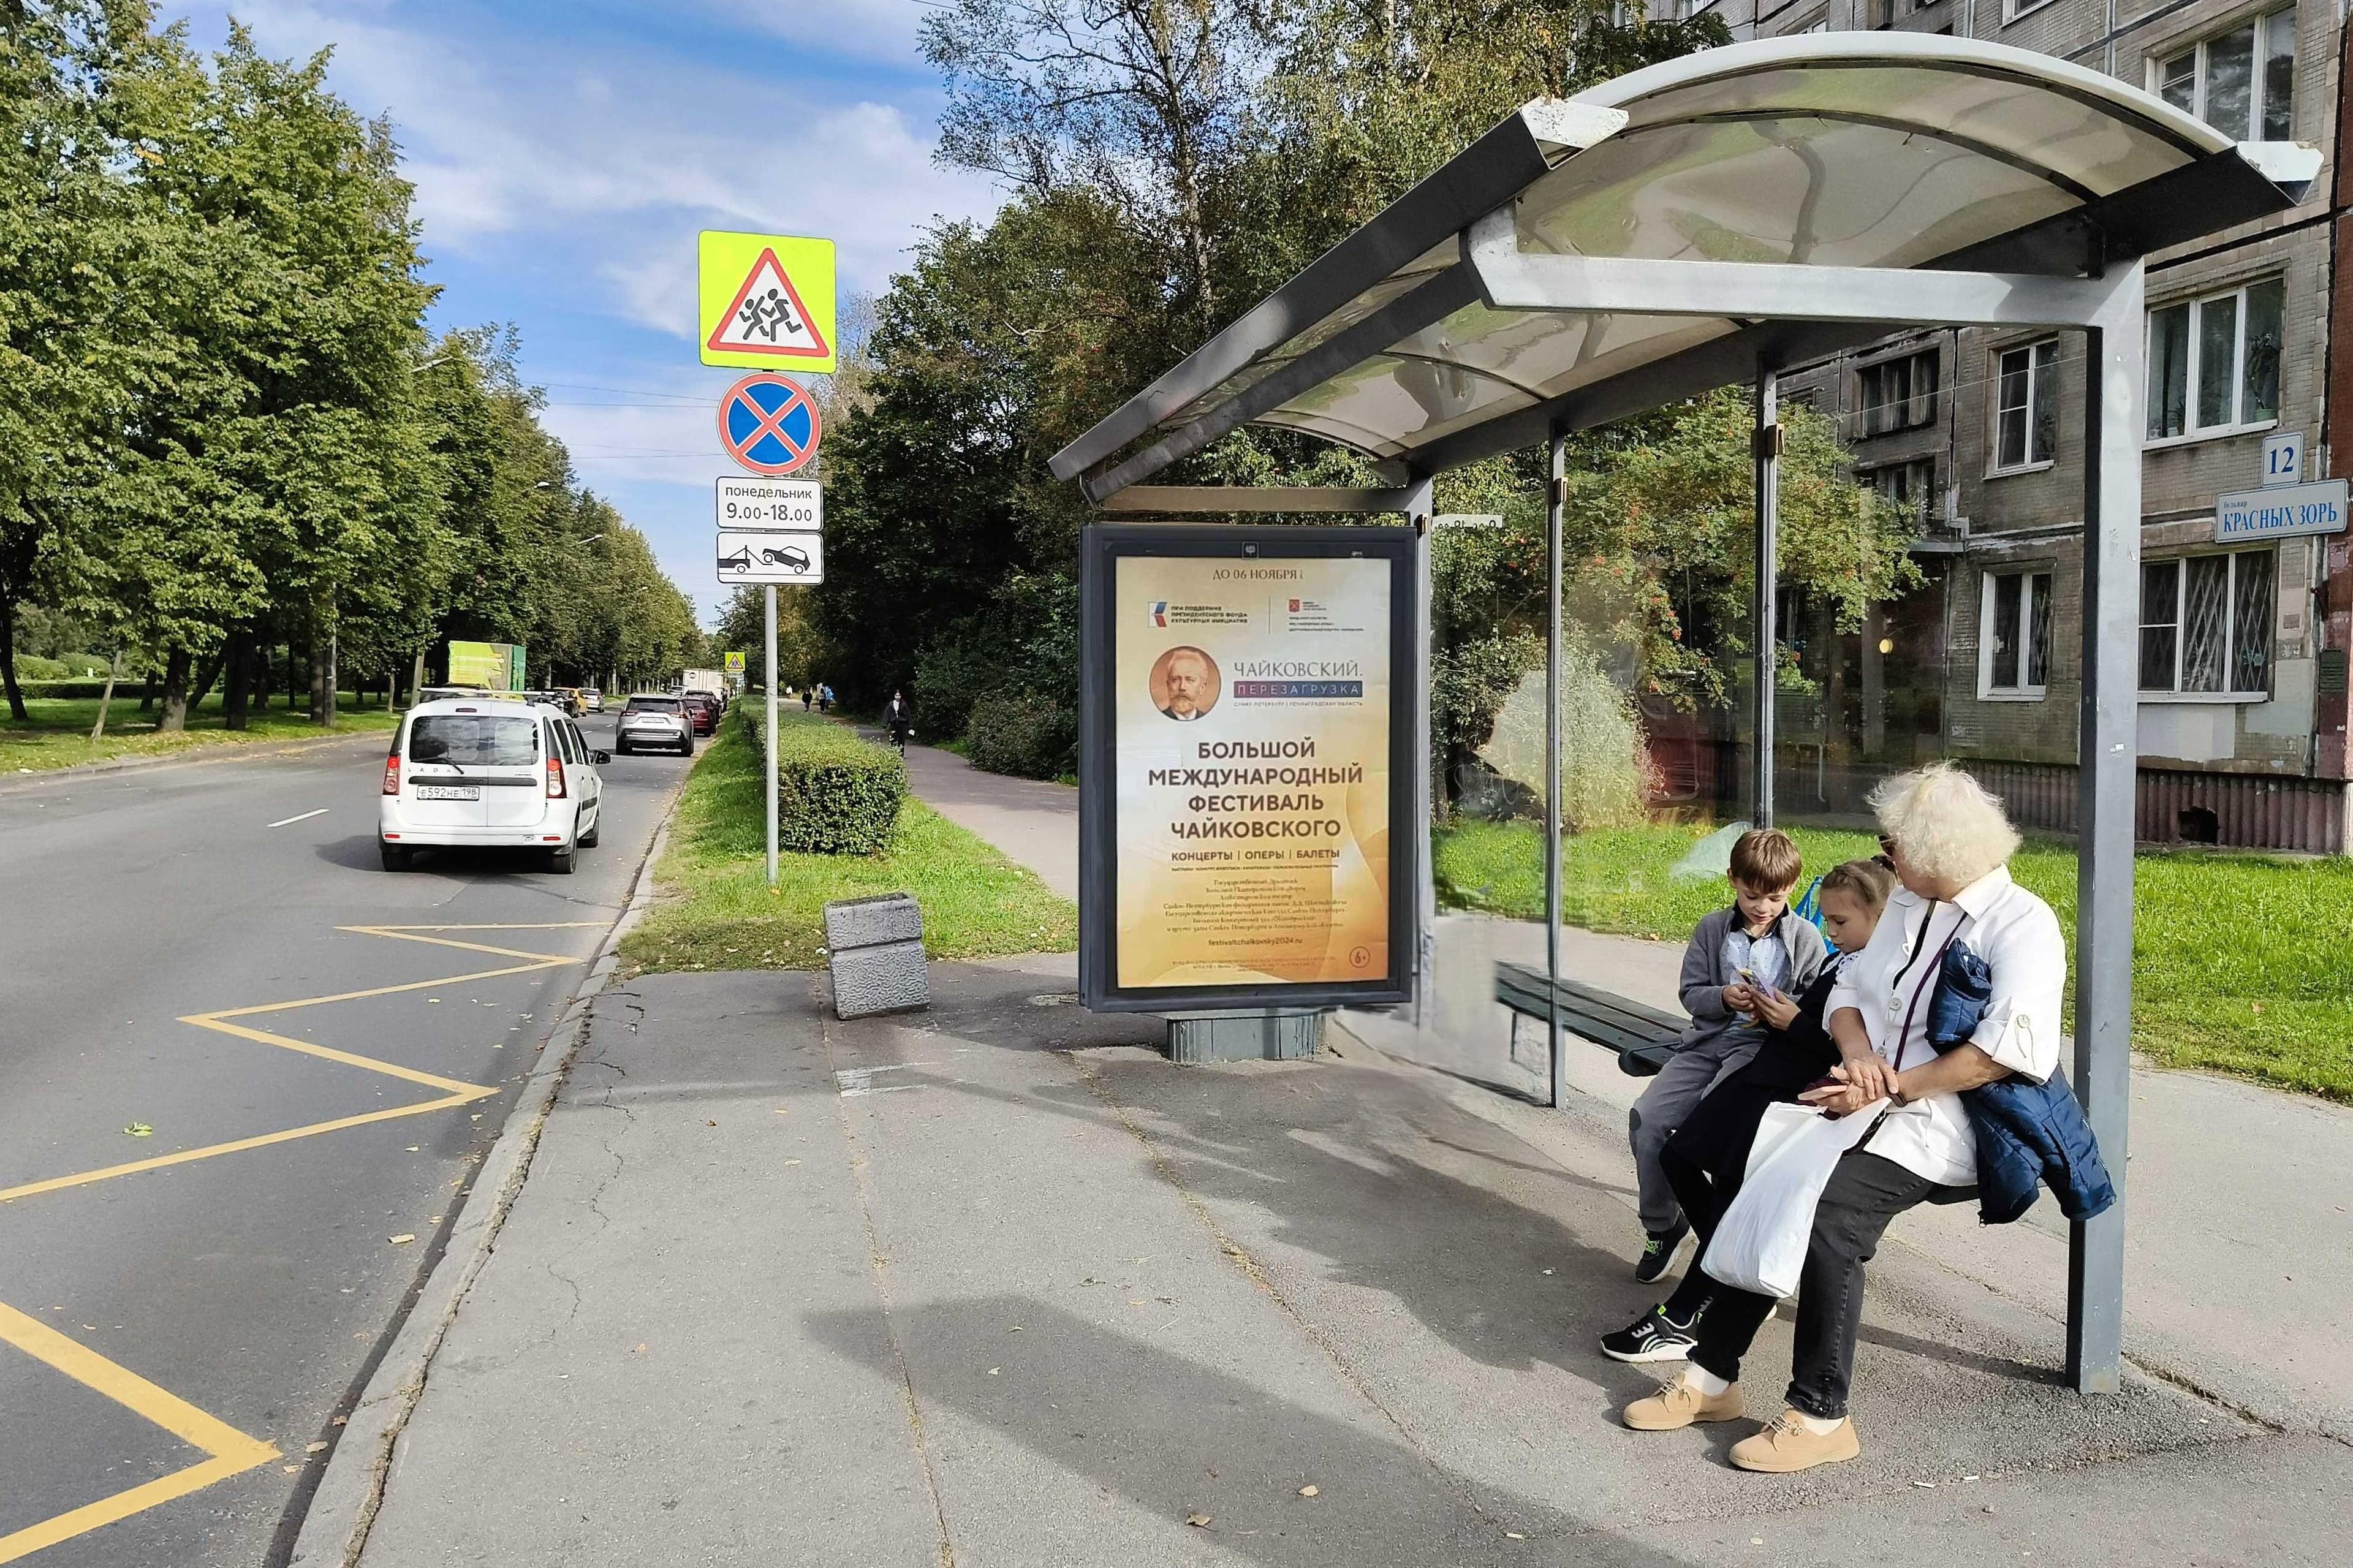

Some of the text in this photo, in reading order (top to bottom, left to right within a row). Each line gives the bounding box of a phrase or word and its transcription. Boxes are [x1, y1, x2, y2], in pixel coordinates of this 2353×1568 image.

[2269, 447, 2294, 474] 12
[726, 487, 812, 499] понедельник
[727, 502, 812, 521] 9.00-18.00
[2224, 502, 2337, 532] КРАСНЫХ ЗОРЬ
[1213, 569, 1230, 580] ДО
[1233, 569, 1246, 579] 06
[1251, 569, 1297, 580] НОЯБРЯ
[1237, 684, 1358, 695] ПЕРЕЗАГРУЗКА
[1198, 737, 1315, 759] БОЛЬШОЙ
[1148, 762, 1363, 788] МЕЖДУНАРОДНЫЙ
[1188, 794, 1324, 812] ФЕСТИВАЛЬ
[1171, 817, 1341, 839] ЧАЙКОВСКОГО
[1172, 849, 1339, 862] КОНЦЕРТЫ ОПЕРЫ БАЛЕТЫ
[1354, 951, 1366, 964] 6+
